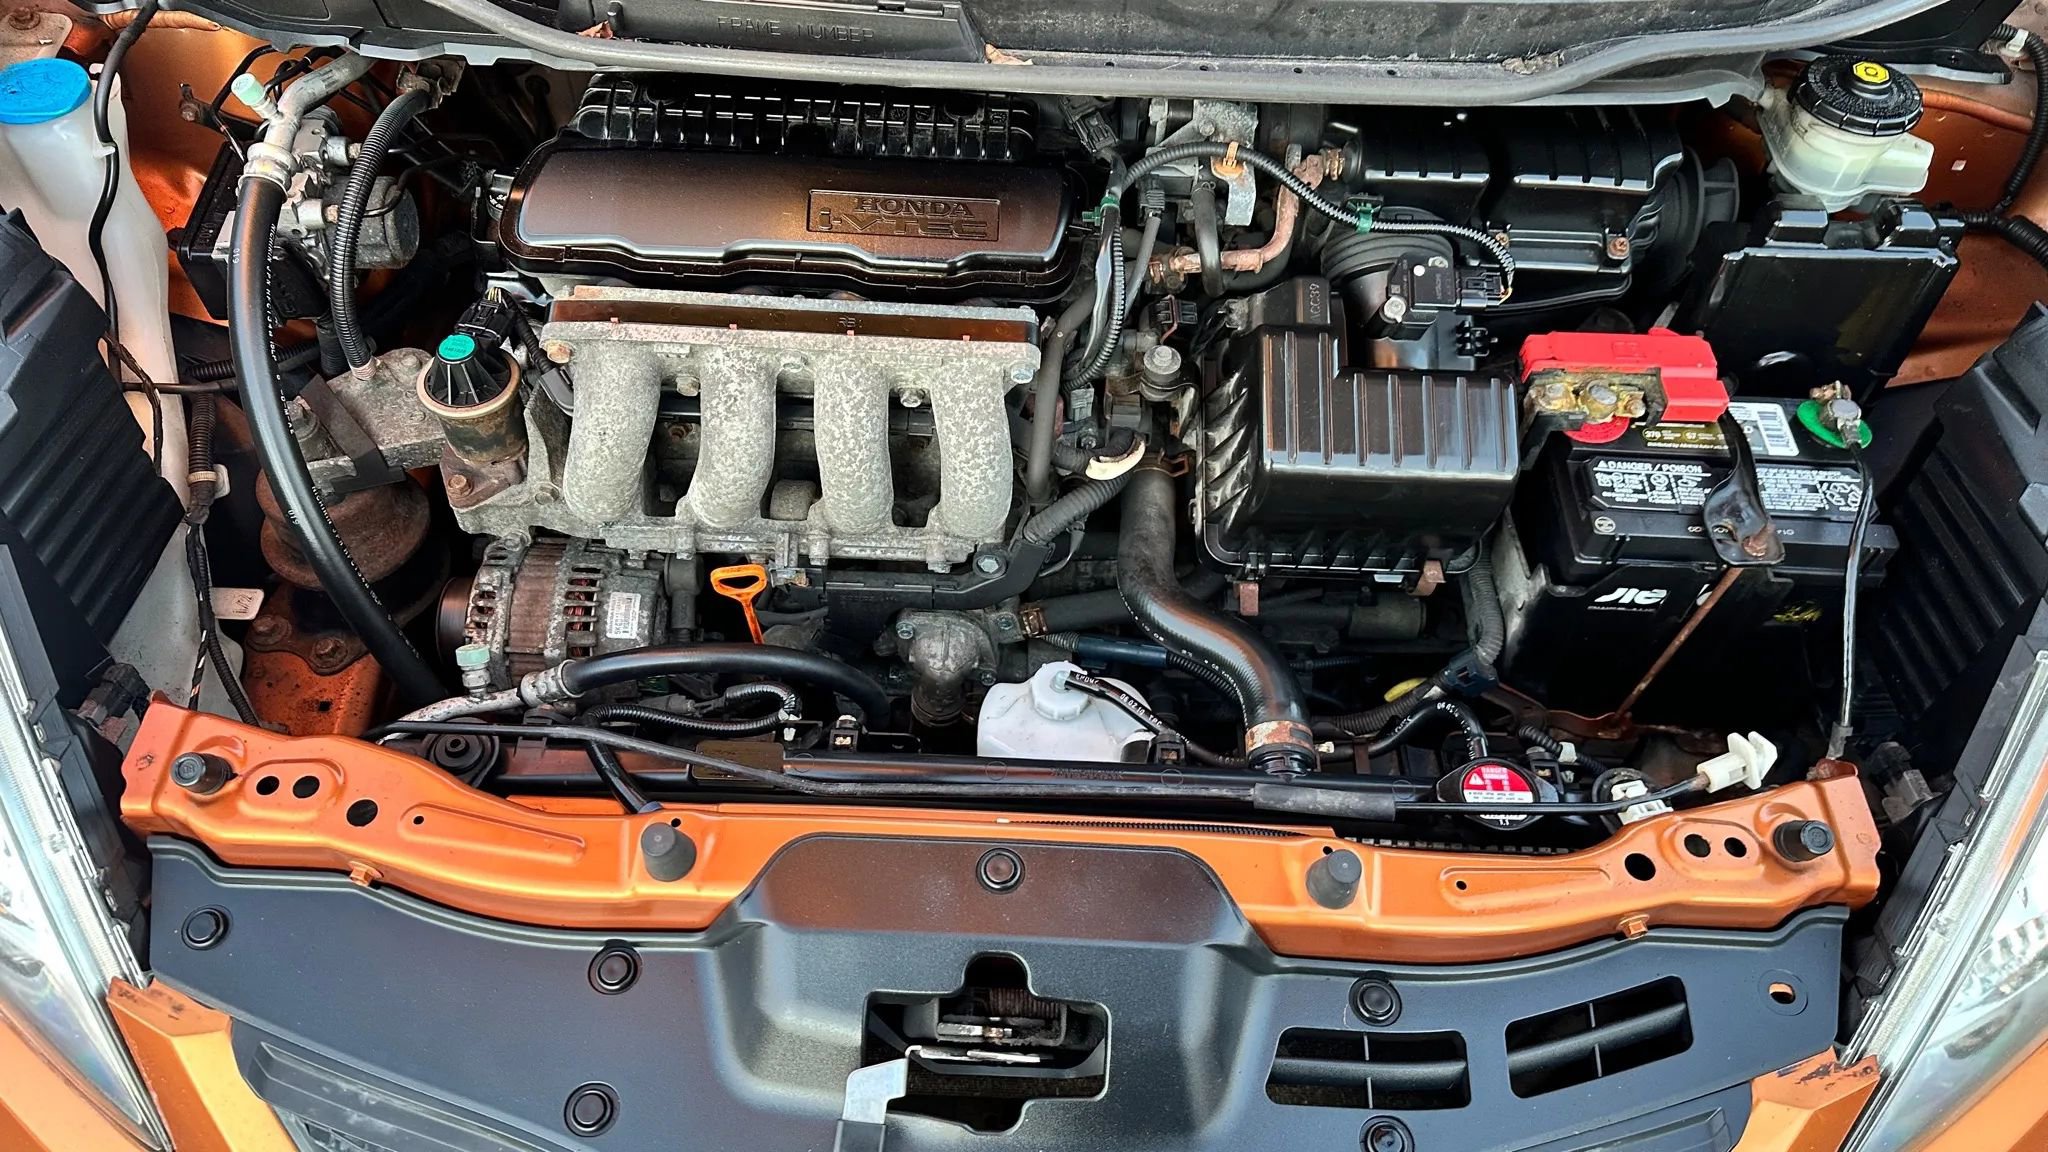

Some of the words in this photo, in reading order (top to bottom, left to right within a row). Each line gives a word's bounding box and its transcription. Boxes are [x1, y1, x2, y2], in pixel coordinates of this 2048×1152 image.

[717, 16, 781, 36] FRAME
[797, 23, 875, 42] NUMBER
[853, 197, 975, 218] HONDA
[1608, 461, 1653, 473] DANGER
[1661, 463, 1703, 474] POISON
